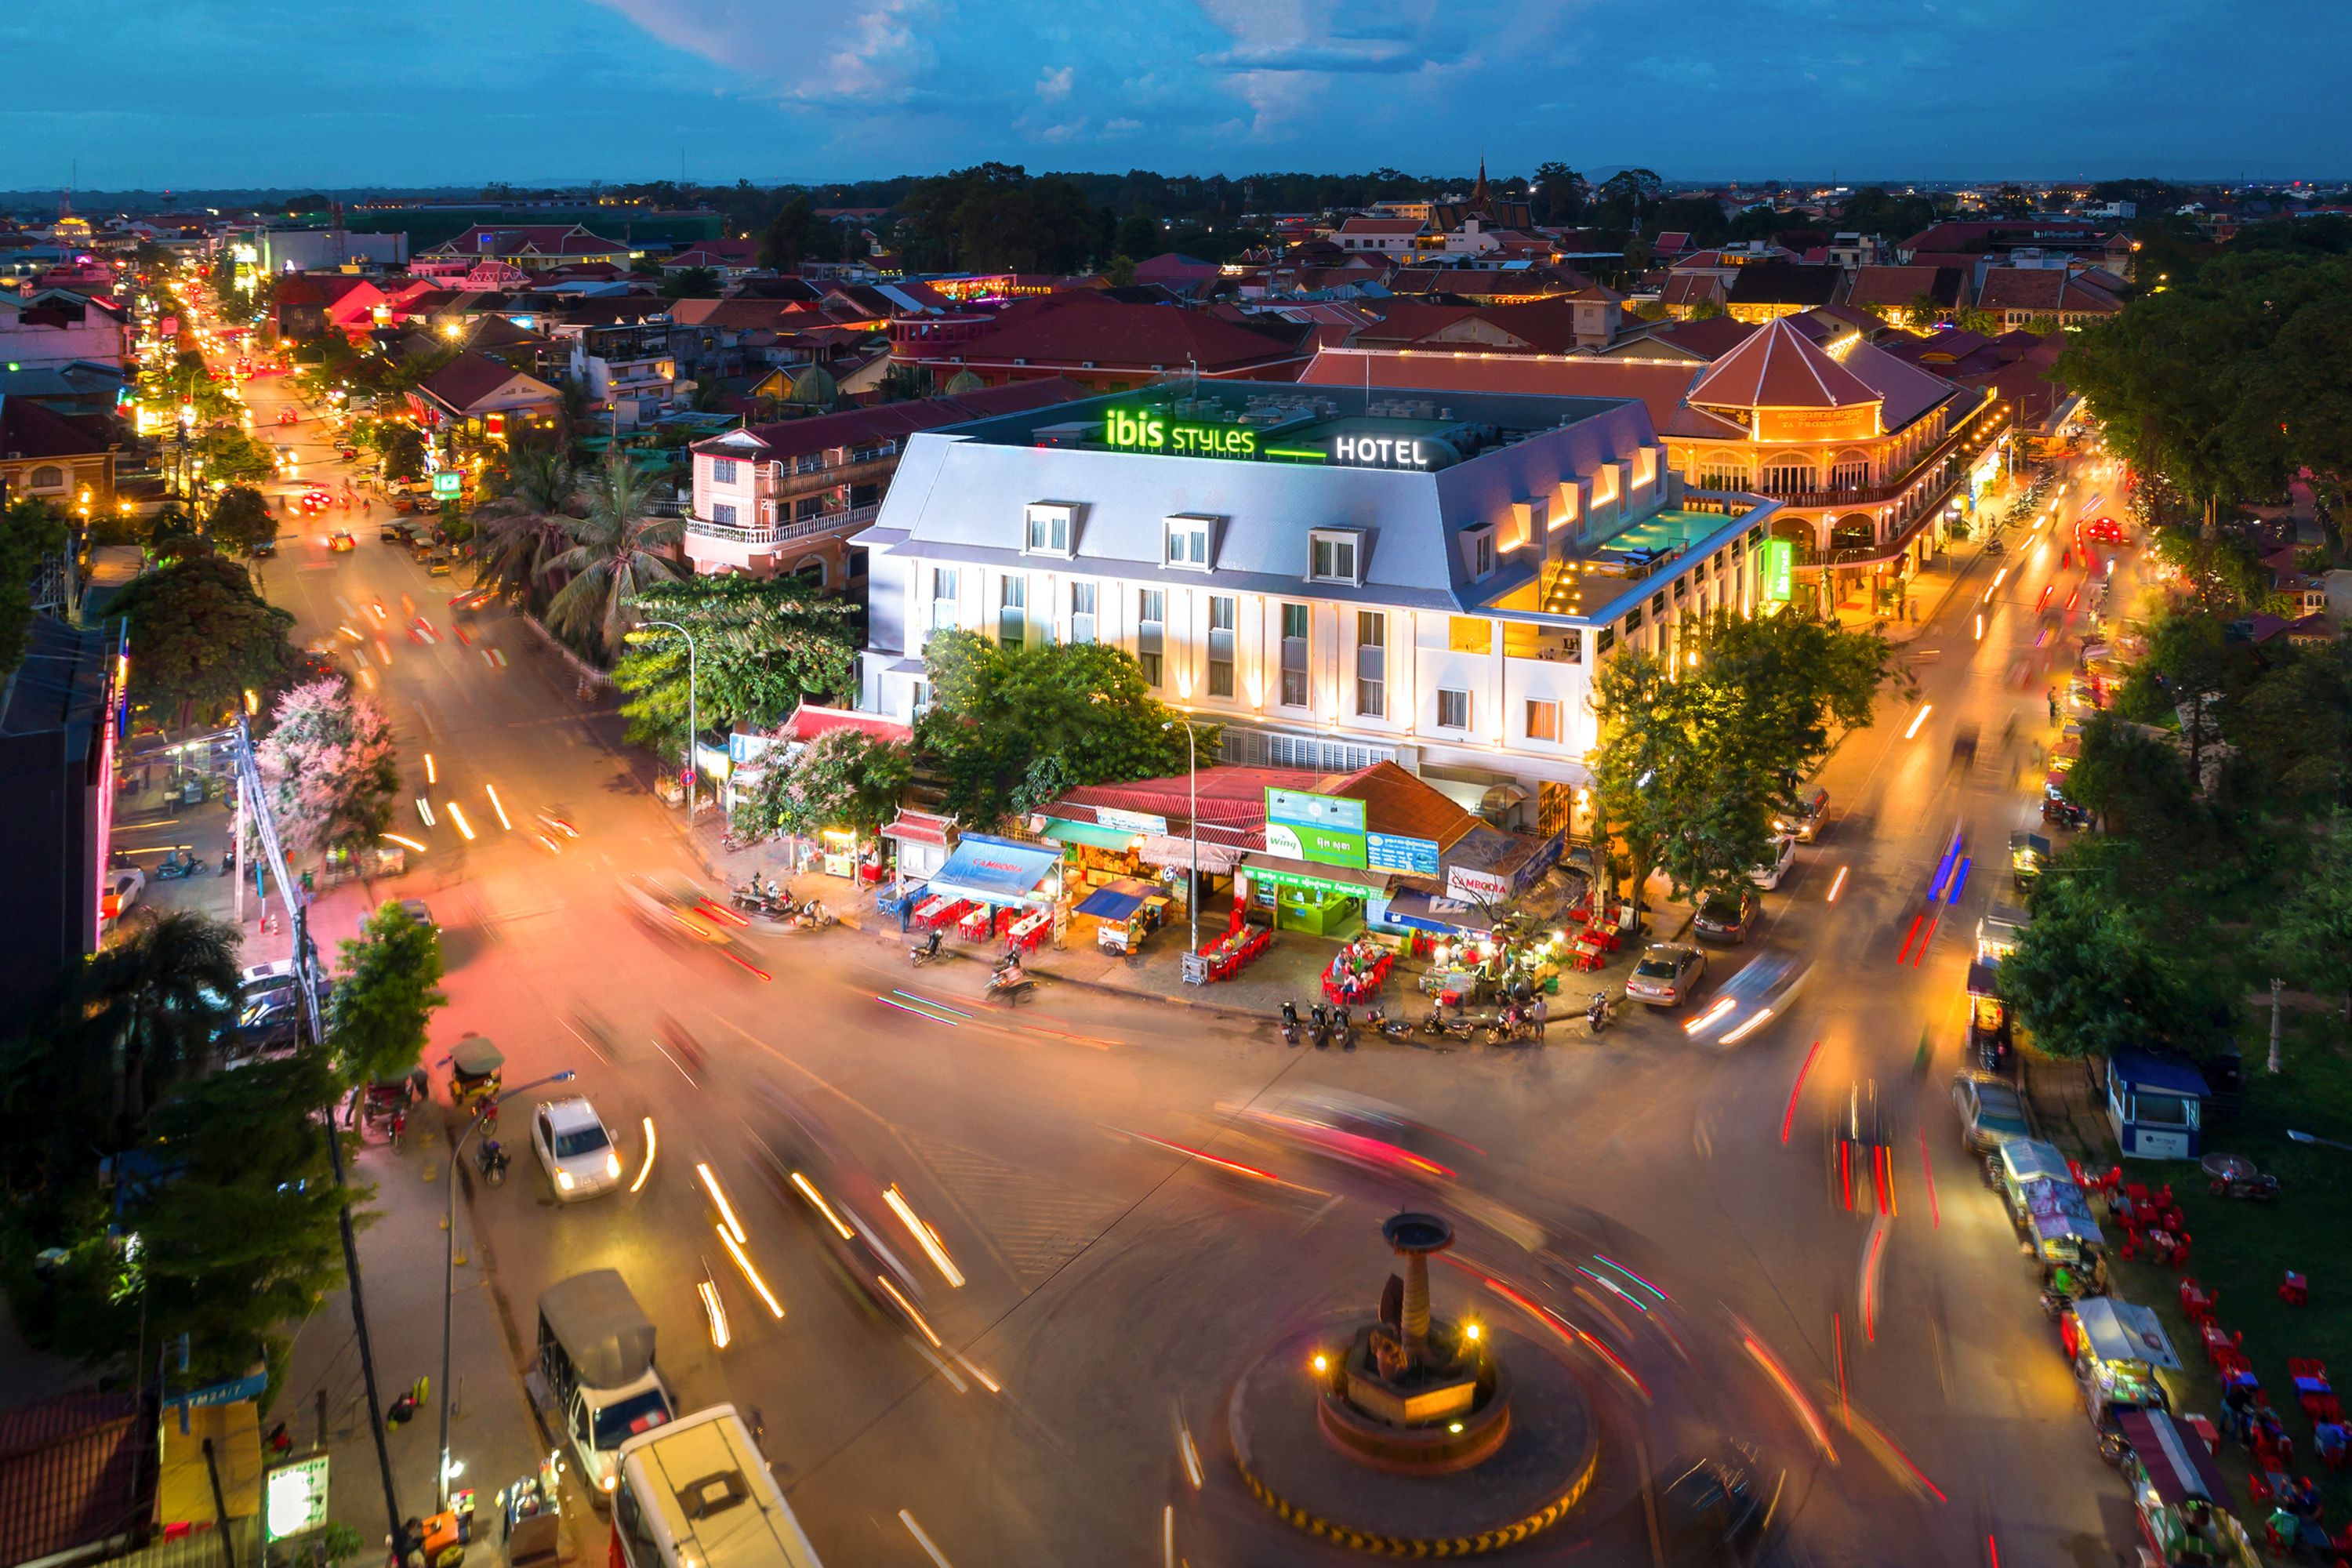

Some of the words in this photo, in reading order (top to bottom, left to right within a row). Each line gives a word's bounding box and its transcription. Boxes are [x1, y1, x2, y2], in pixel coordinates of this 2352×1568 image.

[1106, 409, 1164, 447] ibis
[1336, 437, 1427, 465] HOTEL
[1270, 837, 1297, 851] Wing
[1451, 875, 1506, 894] CAMBODIA
[180, 1385, 241, 1409] TM24/7
